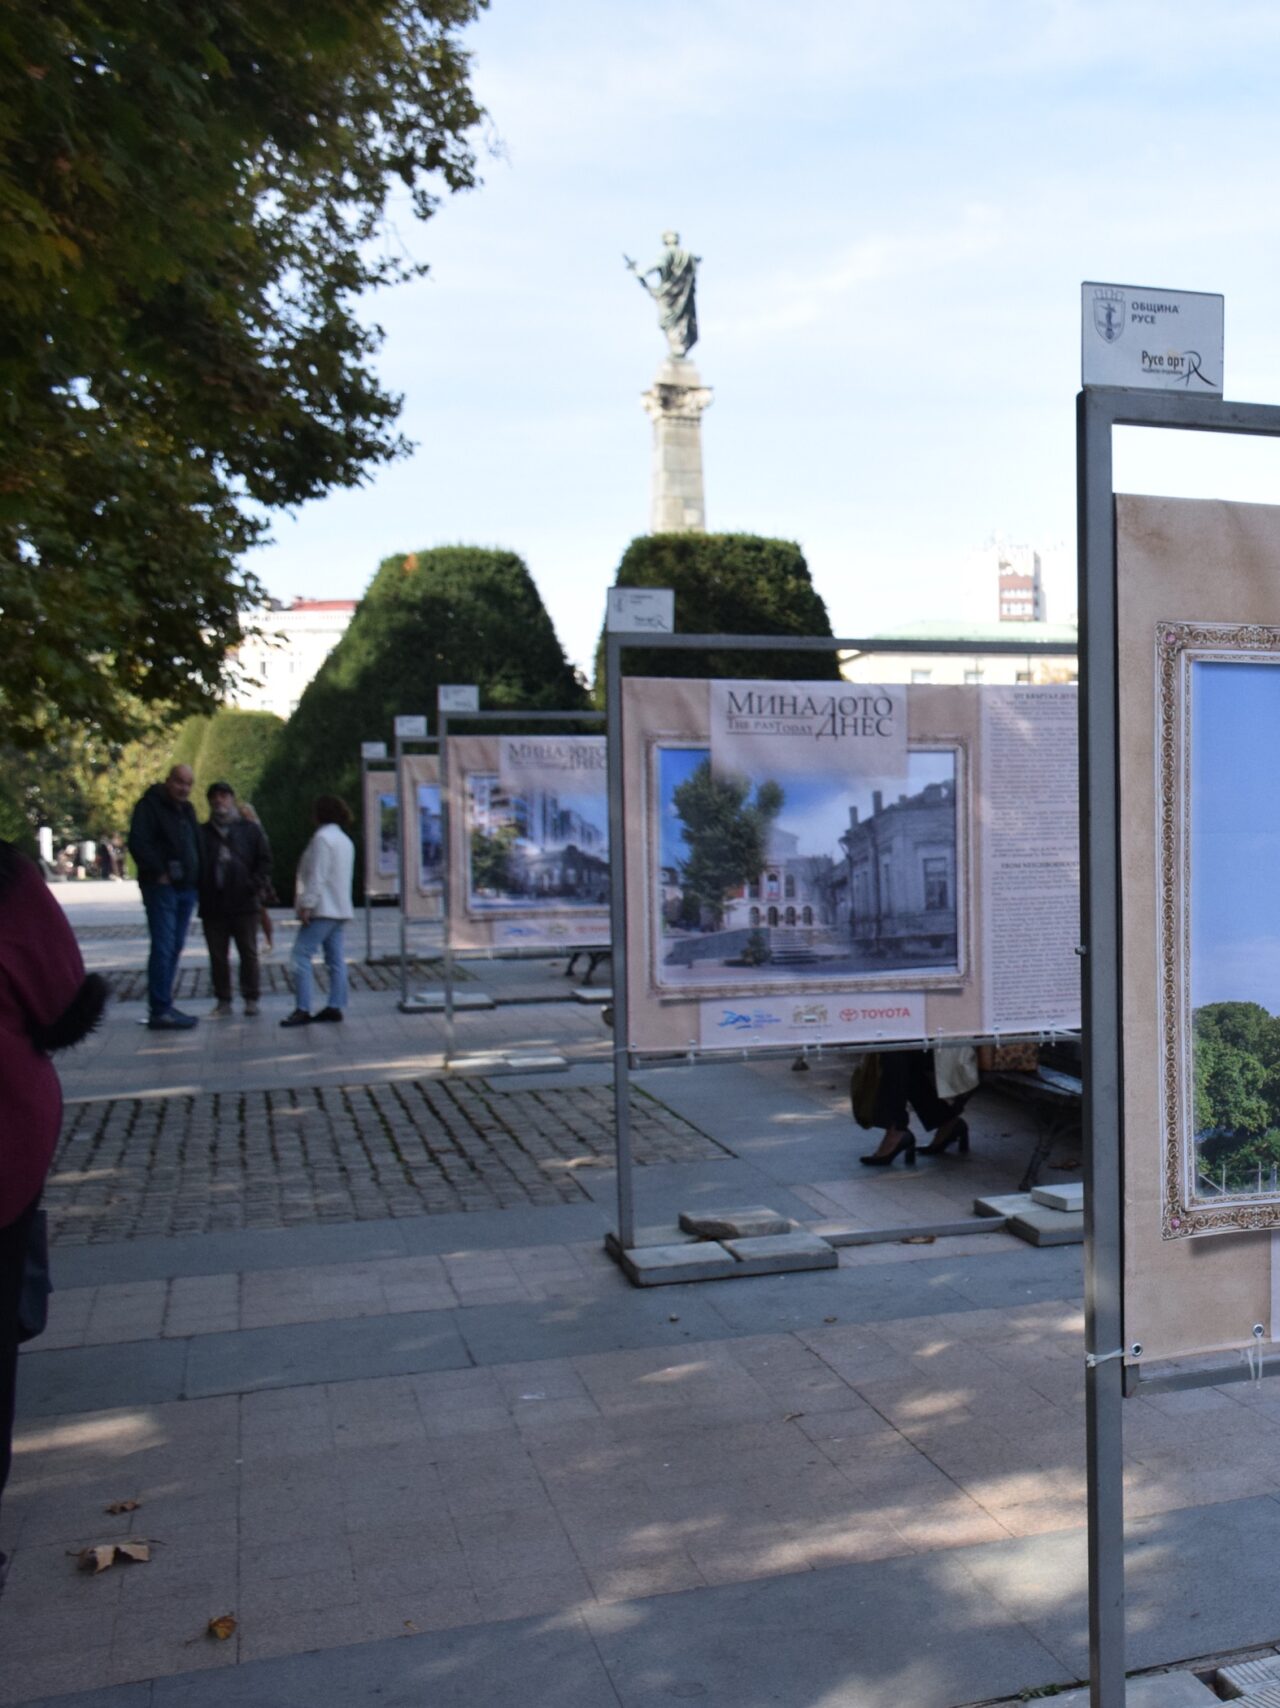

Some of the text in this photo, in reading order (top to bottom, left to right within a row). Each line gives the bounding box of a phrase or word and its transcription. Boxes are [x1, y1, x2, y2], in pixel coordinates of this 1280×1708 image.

[1131, 301, 1179, 314] ОБЩИНА
[1131, 314, 1156, 325] РУСЕ
[1141, 350, 1185, 369] Русе арт
[860, 1007, 911, 1020] TOYOTA
